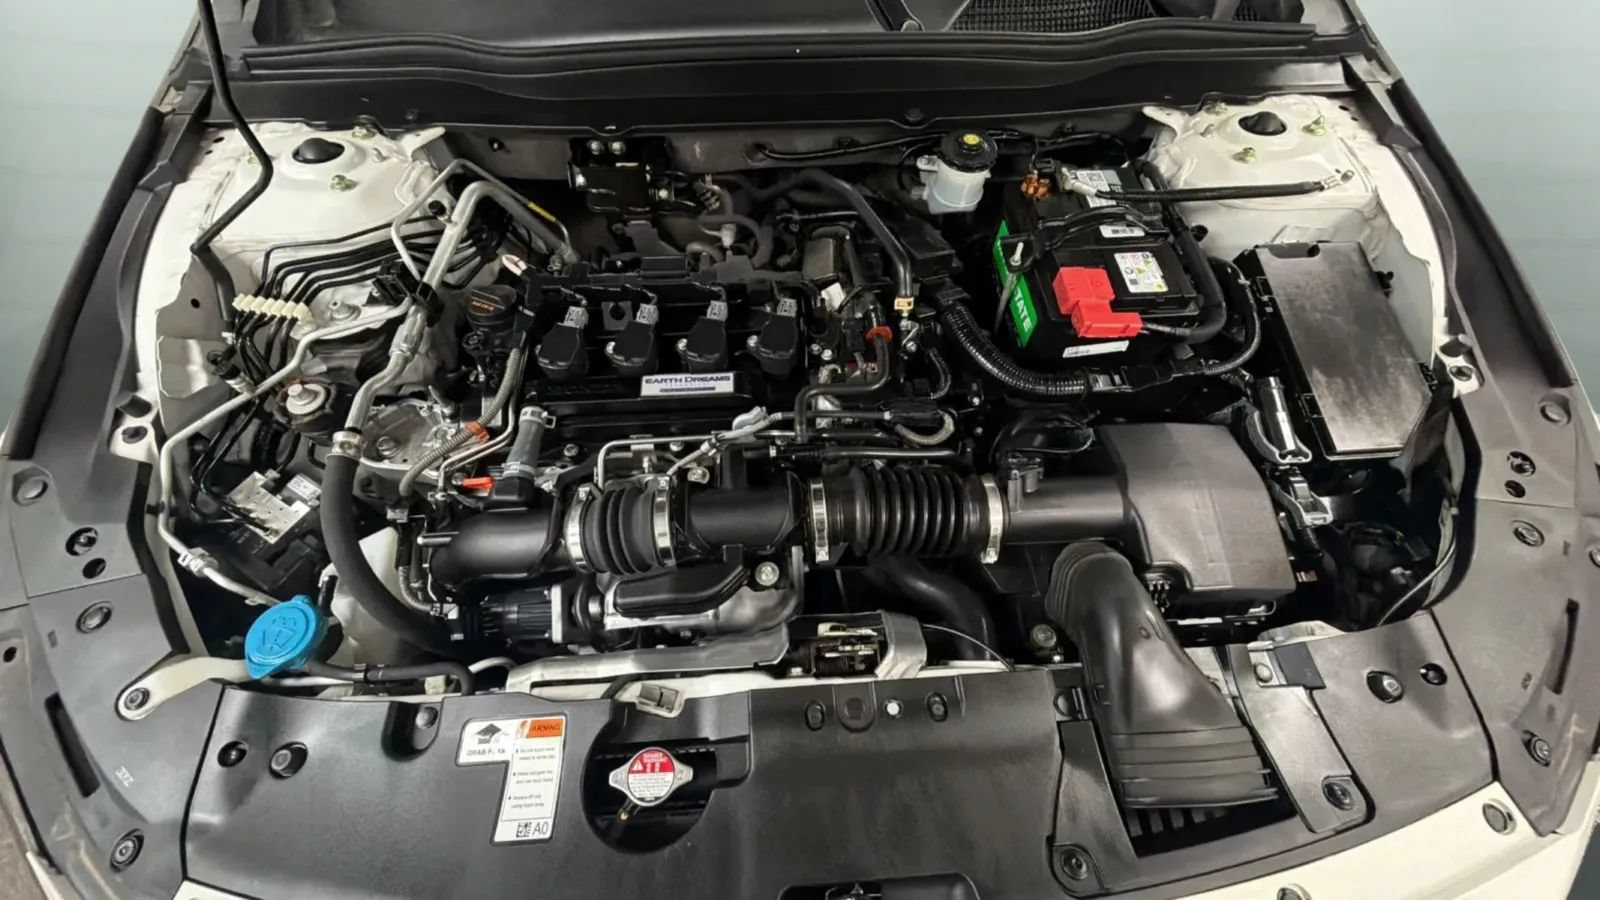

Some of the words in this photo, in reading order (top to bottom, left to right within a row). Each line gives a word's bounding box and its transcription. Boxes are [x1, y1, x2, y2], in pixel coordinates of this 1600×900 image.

[1014, 286, 1033, 332] TATE
[685, 375, 731, 383] DREAMS
[532, 821, 549, 836] A0
